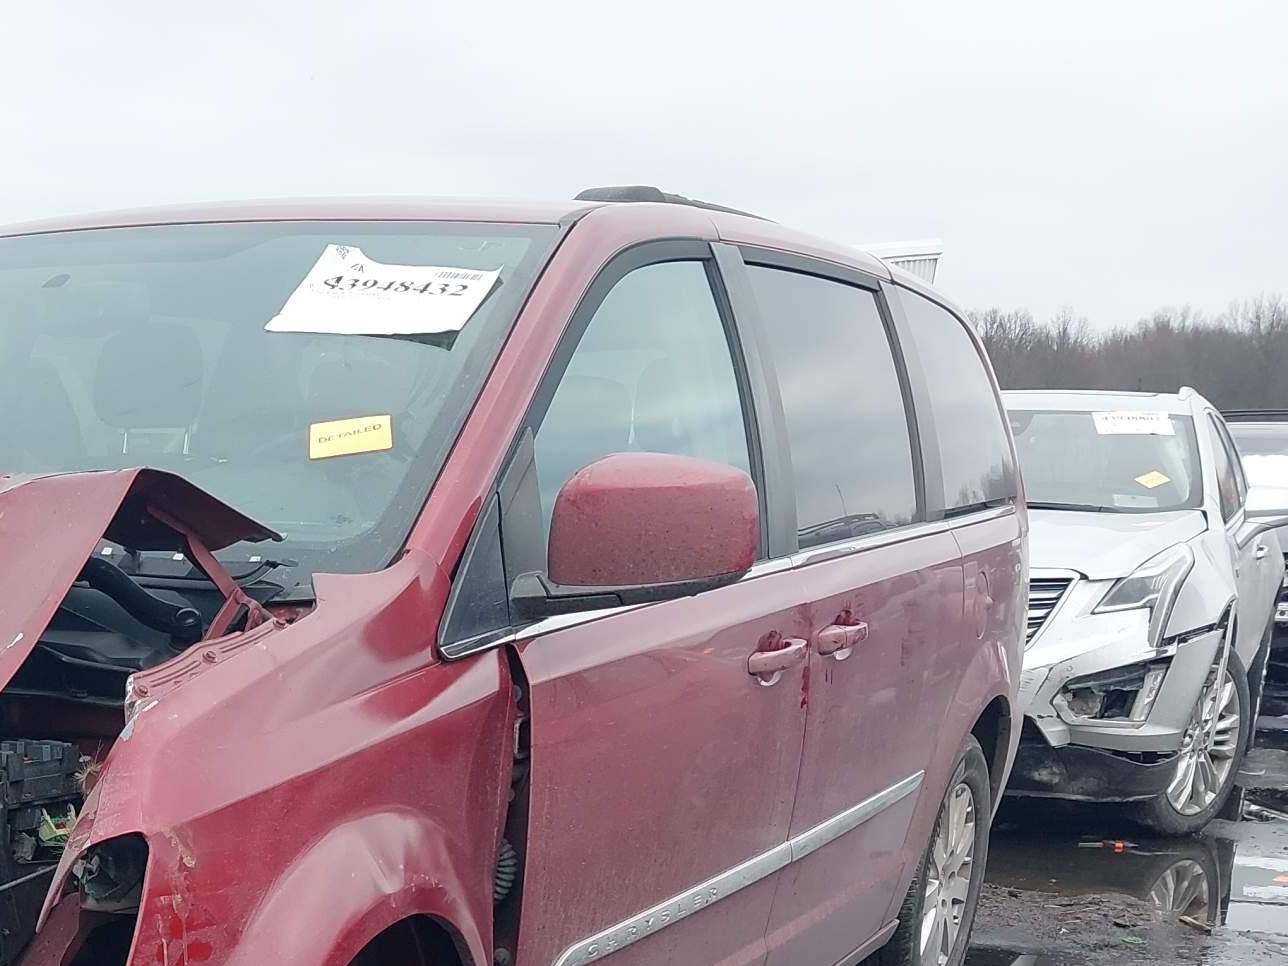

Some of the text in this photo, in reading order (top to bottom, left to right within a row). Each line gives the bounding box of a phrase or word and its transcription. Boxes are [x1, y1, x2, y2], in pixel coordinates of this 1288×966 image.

[322, 274, 469, 297] 43948432
[318, 423, 383, 444] DETAILED
[587, 887, 718, 958] CHRYSLER
